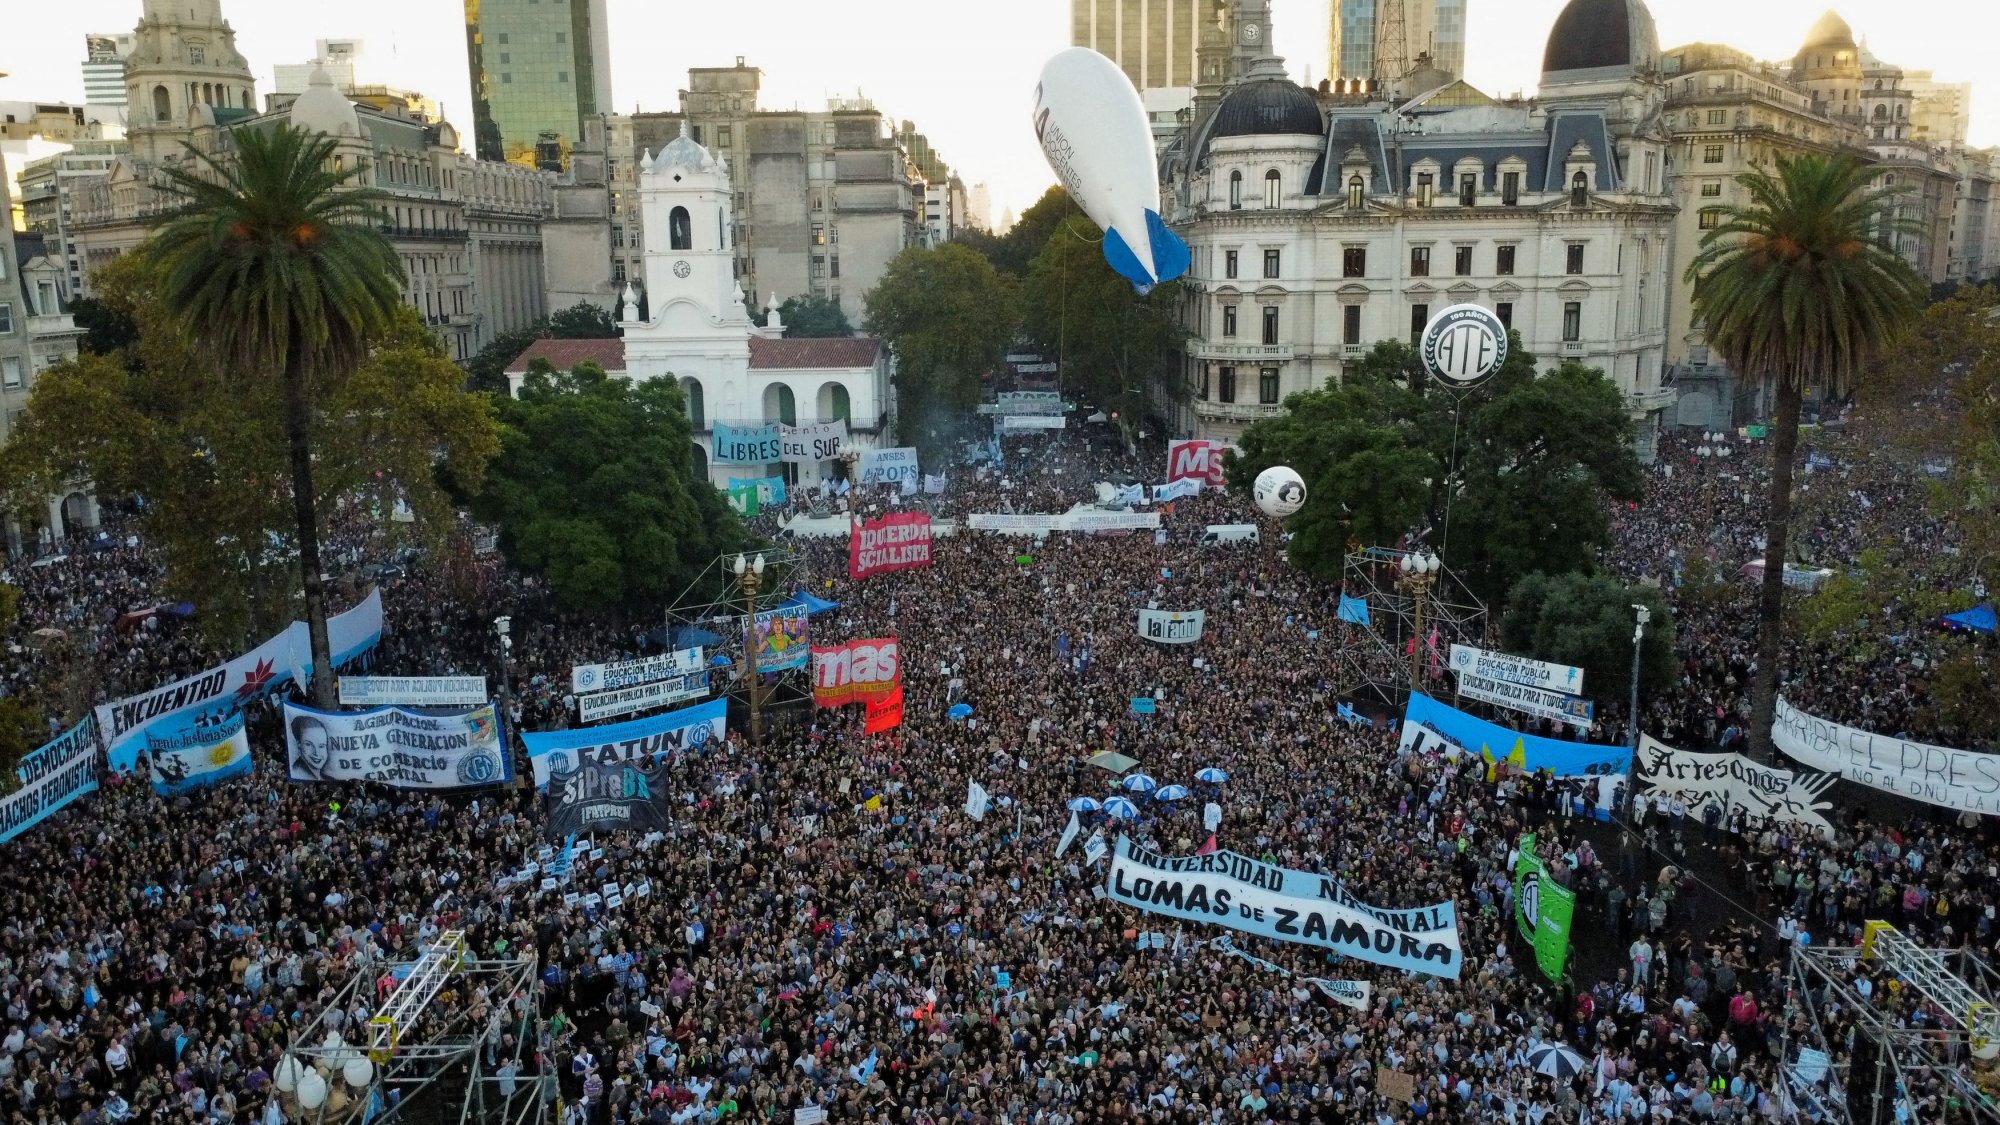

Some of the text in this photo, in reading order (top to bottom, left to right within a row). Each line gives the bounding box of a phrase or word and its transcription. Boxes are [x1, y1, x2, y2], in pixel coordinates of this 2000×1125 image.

[1050, 121, 1074, 160] UNION
[1045, 131, 1082, 189] DOCENTES
[1450, 310, 1488, 322] 100 AÑOS
[1438, 324, 1491, 375] ATE
[784, 442, 807, 456] DEL
[877, 452, 906, 462] ANSES
[862, 464, 918, 482] APOPS
[603, 659, 677, 680] EDUCACION PUBLICA
[604, 669, 675, 688] GASTON FRUTOS
[815, 643, 897, 688] mas
[1475, 666, 1505, 678] GASTON
[1507, 672, 1537, 685] FRUTOS
[1477, 657, 1551, 681] EDUCACION PUBLICA
[1525, 659, 1534, 667] DE
[111, 668, 227, 738] ENCUENTRO
[584, 695, 618, 710] EDUCACION
[619, 688, 644, 703] PUBLICA
[1462, 674, 1495, 691] EDUCACION
[1495, 681, 1522, 699] PUBLICA
[1523, 688, 1540, 705] PARA
[1542, 694, 1565, 710] TODOS
[23, 717, 97, 786] DEMOCRACIA
[328, 728, 468, 751] NUEVA GENERACION
[578, 728, 684, 763] FATUN
[1850, 732, 1883, 771] EL
[338, 758, 362, 770] DE
[370, 751, 448, 771] COMERCIO
[364, 765, 433, 784] CAPITAL
[1647, 745, 1790, 795] Artesanos
[41, 754, 98, 810] PERONISTAS
[1852, 768, 1873, 784] NO
[1883, 775, 1899, 791] AL
[1964, 793, 1984, 811] LA
[1127, 842, 1284, 893] UNIVERSIDAD
[1115, 868, 1452, 965] LOMAS DE ZAMORA
